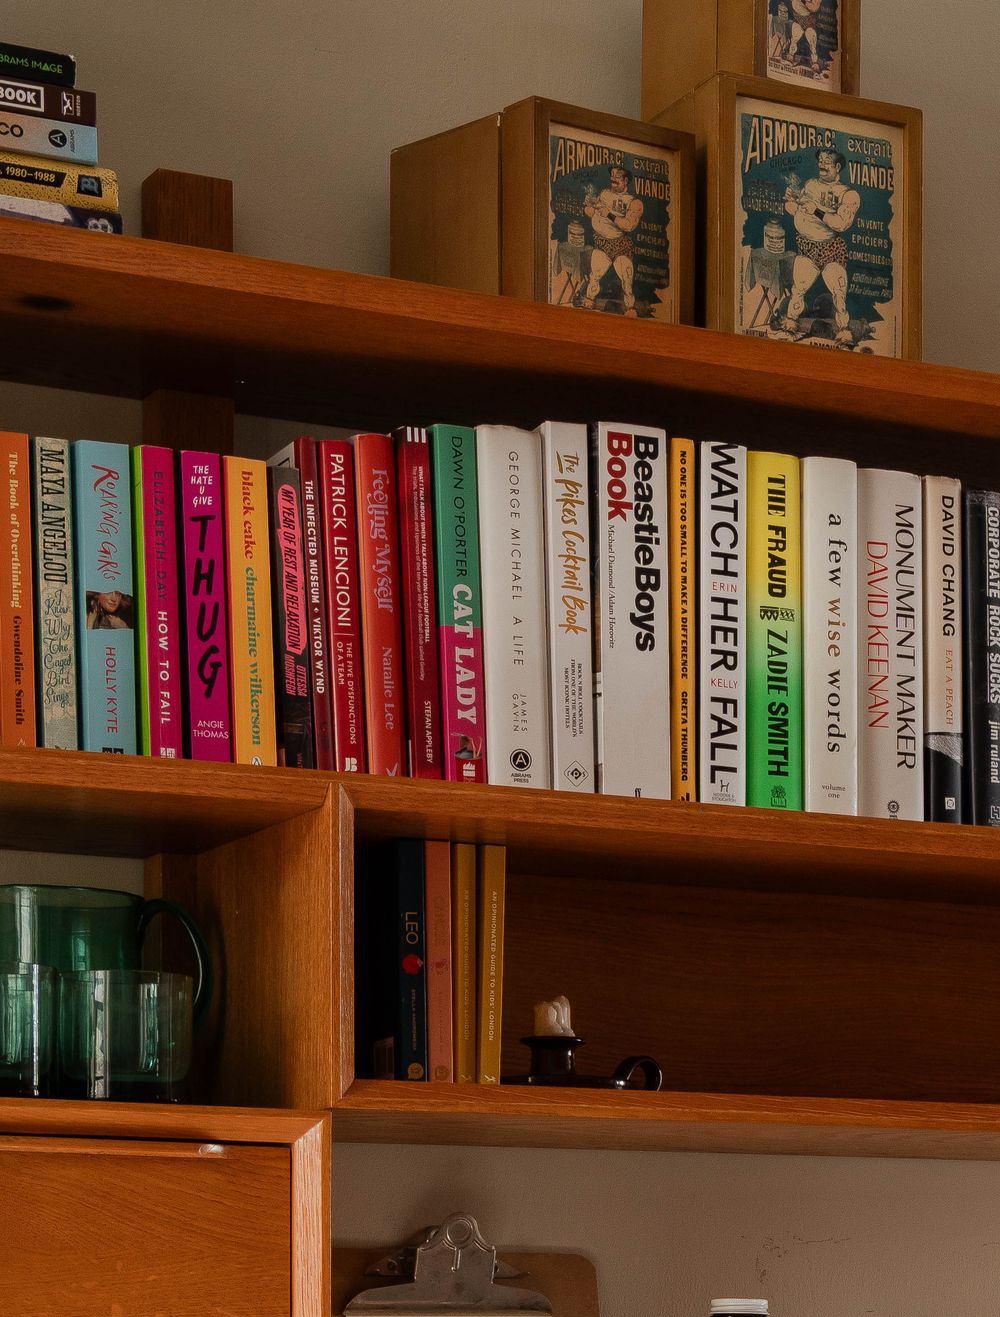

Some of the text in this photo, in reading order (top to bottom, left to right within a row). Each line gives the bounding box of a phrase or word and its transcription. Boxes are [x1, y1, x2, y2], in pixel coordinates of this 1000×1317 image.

[31, 61, 63, 74] IMAGE
[633, 158, 670, 175] extrait
[634, 177, 670, 201] VIANDE
[847, 138, 893, 159] extrait
[848, 160, 895, 190] VIANDE
[40, 447, 68, 584] MAYA ANGELOU
[191, 475, 213, 485] HATE
[193, 496, 213, 507] GIVE
[199, 486, 205, 495] U
[242, 471, 254, 559] black cake
[451, 435, 468, 578] DAWN O'PORTER
[606, 430, 633, 523] Book
[710, 441, 739, 577] WATCH
[153, 471, 167, 600] ELIZABETH DAY
[305, 480, 319, 603] THE INFECTED MUSEUM
[330, 453, 351, 627] PATRICK LENCIONI
[508, 451, 522, 600] GEORGE MICHAEL
[767, 474, 787, 598] THE FRAUD
[941, 495, 955, 637] DAVID CHANG
[988, 506, 1000, 599] CORPORATE
[44, 596, 70, 614] Know
[712, 581, 738, 594] ERIN
[989, 604, 1000, 648] ROCK
[44, 618, 70, 640] Why
[158, 611, 170, 725] HOW TO FAIL
[310, 618, 325, 694] VIKTOR WYND
[453, 583, 477, 724] CAT LADY
[710, 596, 739, 672] HER
[827, 513, 849, 753] a few wise words
[866, 541, 889, 729] DAVID KEENAN
[895, 504, 916, 770] MONUMENT MAKER
[105, 646, 119, 734] HOLLY KYTE
[710, 677, 739, 690] KELLY
[767, 629, 789, 777] ZADIE SMITH
[193, 729, 229, 740] THOMAS
[198, 720, 224, 730] ANGIE
[424, 700, 434, 763] STEFAN APPLEBY
[710, 696, 739, 784] FALL
[822, 784, 846, 793] volume
[405, 911, 419, 945] LEO
